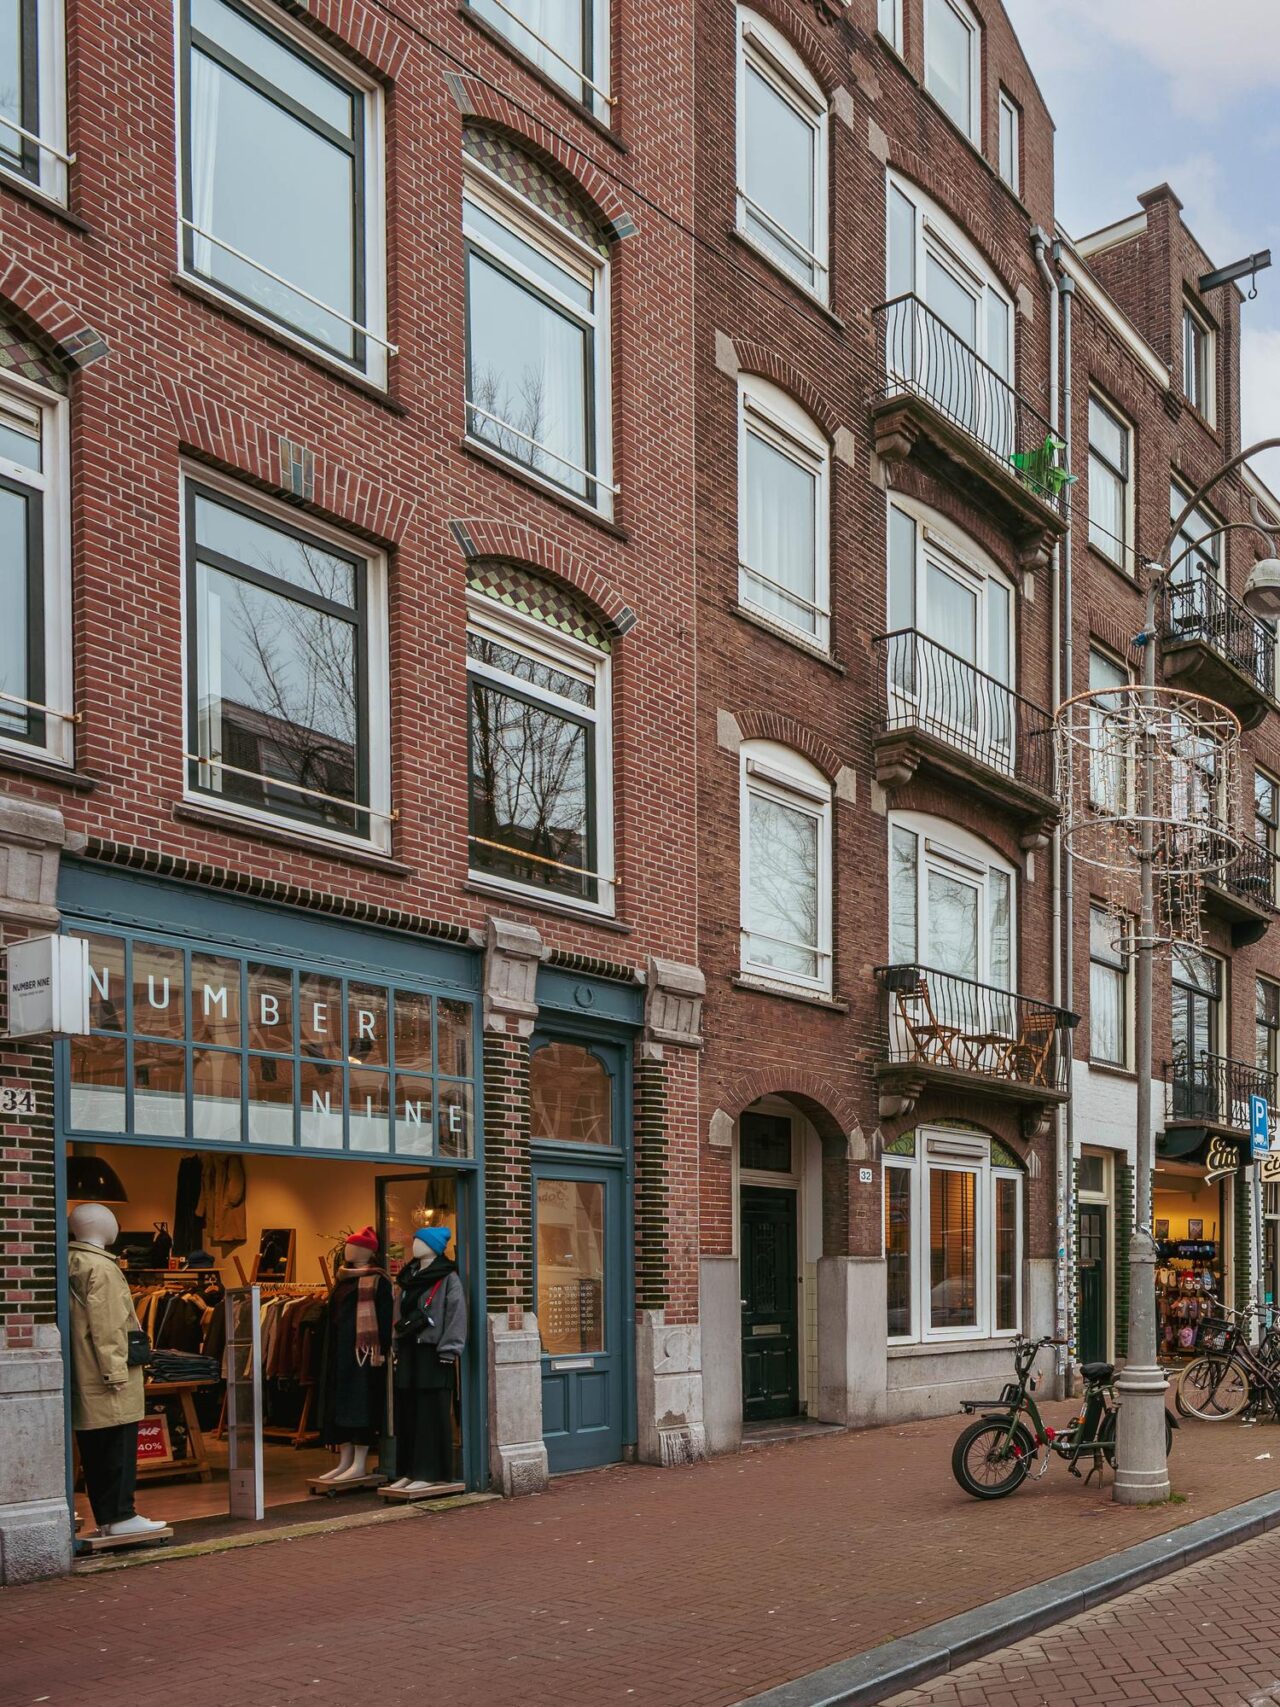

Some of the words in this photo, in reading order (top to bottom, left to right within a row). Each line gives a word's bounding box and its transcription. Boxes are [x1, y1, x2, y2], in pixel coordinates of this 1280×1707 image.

[12, 979, 37, 993] NUMBER
[37, 976, 51, 988] NINE
[88, 965, 376, 1041] NUMBER
[2, 1089, 35, 1113] 34
[312, 1090, 462, 1133] NINE
[1255, 1101, 1265, 1128] P
[860, 1170, 871, 1181] 32
[138, 1426, 161, 1436] ALE
